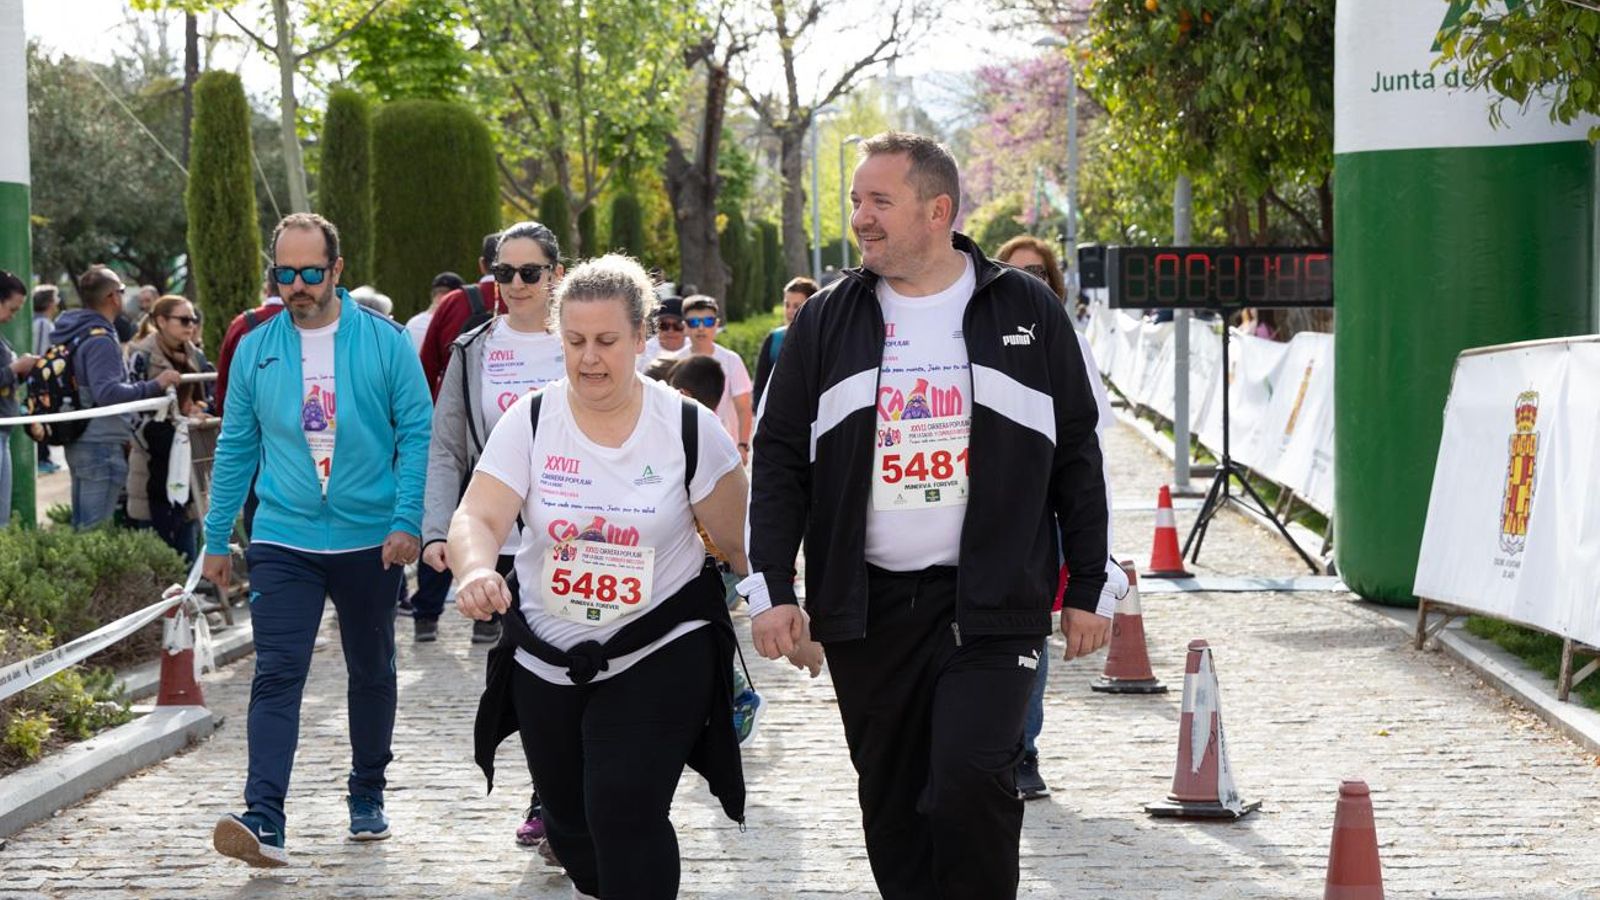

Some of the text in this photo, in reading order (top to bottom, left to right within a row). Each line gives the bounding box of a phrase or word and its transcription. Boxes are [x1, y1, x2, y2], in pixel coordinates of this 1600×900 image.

[1370, 69, 1435, 93] Junta
[1444, 69, 1475, 88] de
[1002, 334, 1031, 346] PUMA
[544, 455, 581, 474] XXVII
[882, 448, 970, 484] 5481
[933, 480, 959, 488] FOREVER
[551, 568, 642, 605] 5483
[570, 599, 620, 610] MINERVA FOREVER
